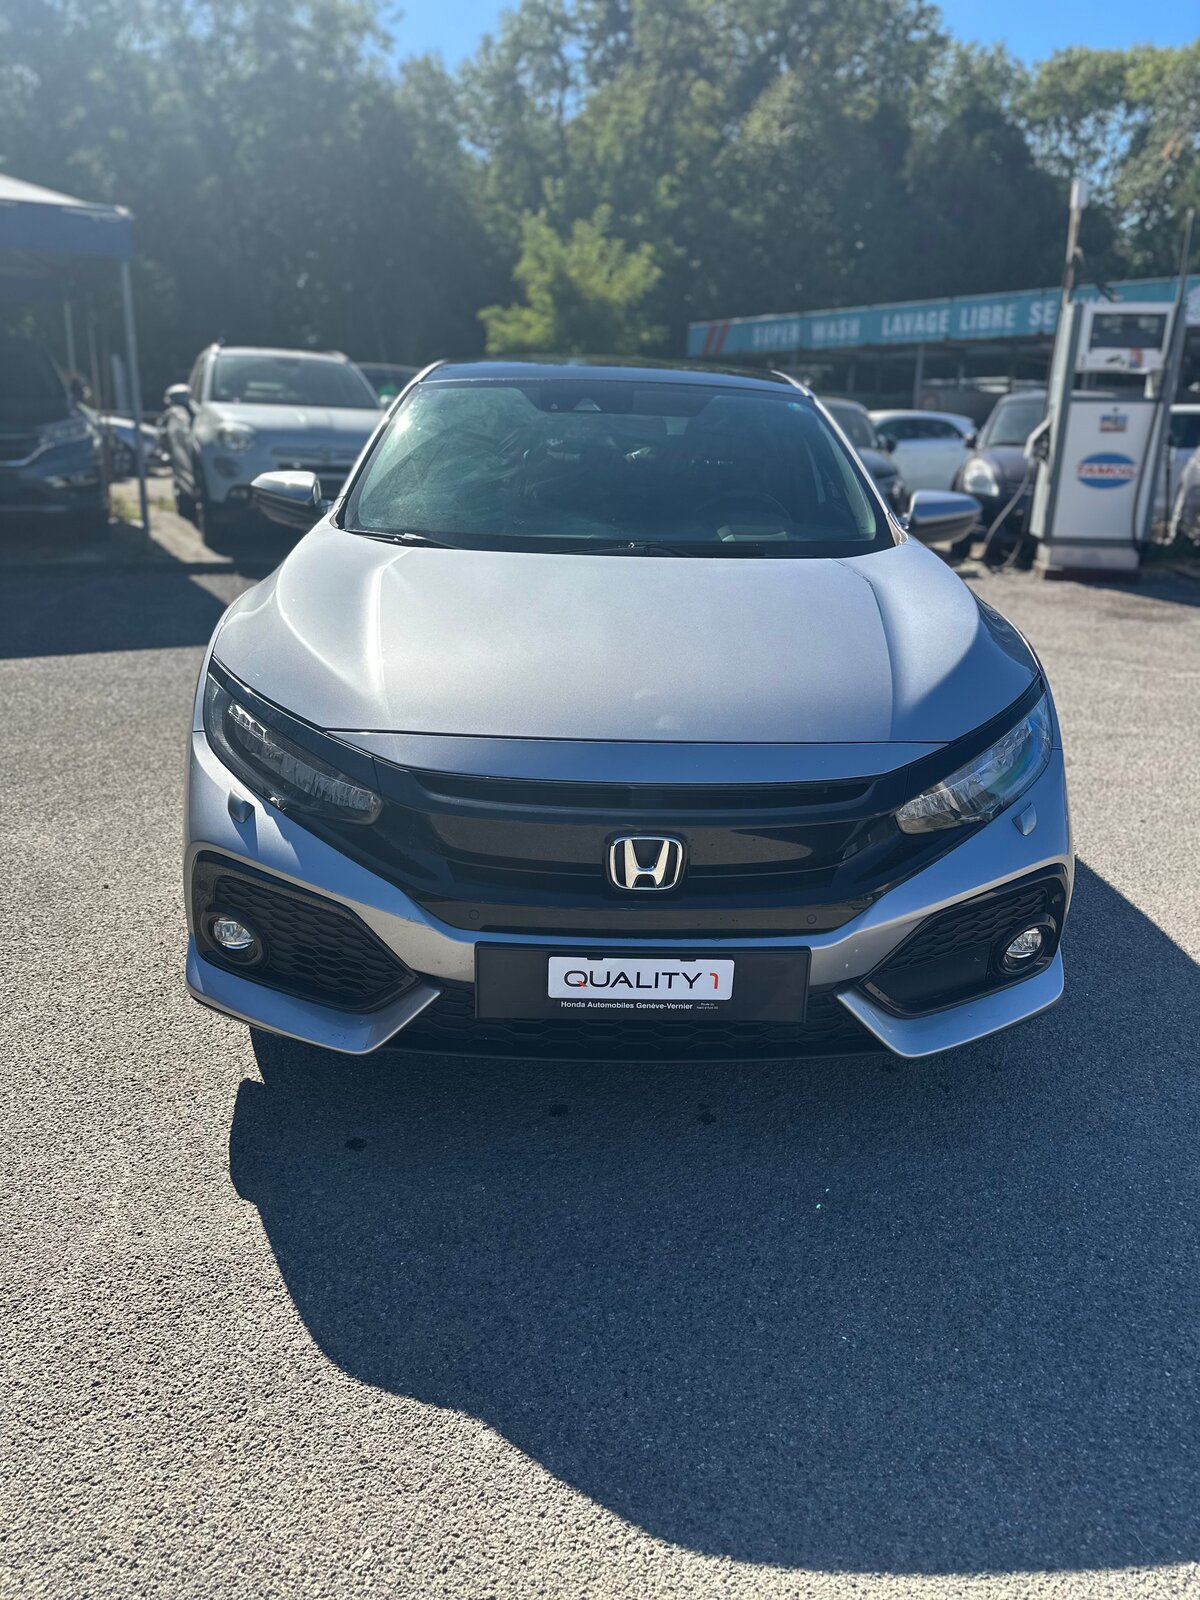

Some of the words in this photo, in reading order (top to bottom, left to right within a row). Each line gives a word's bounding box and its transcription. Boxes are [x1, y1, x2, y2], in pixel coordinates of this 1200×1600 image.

[811, 317, 860, 341] WASH
[881, 309, 950, 337] LAVAGE
[959, 303, 1017, 331] LIBRE
[563, 970, 703, 989] QUALITY
[709, 972, 720, 989] 1
[587, 1001, 635, 1009] Automobiles
